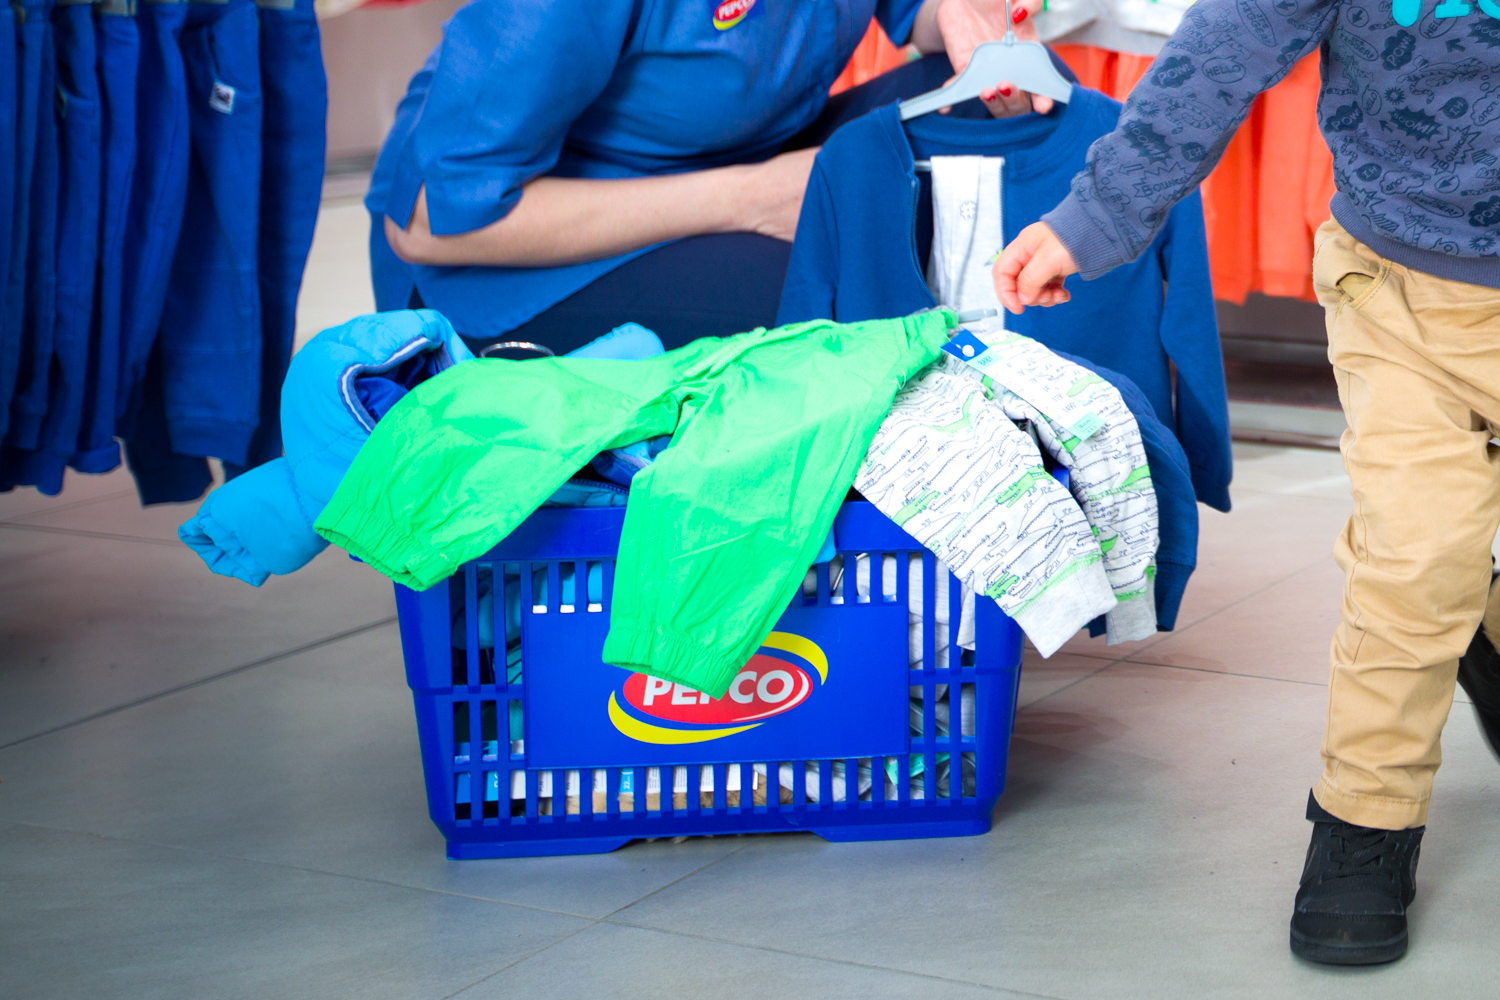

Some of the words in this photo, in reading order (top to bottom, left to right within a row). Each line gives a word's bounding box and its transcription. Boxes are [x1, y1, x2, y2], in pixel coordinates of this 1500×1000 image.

[1386, 34, 1412, 67] POW!
[1158, 63, 1190, 84] POW!
[1205, 63, 1242, 77] HELLO
[1331, 107, 1362, 131] POW!
[1393, 113, 1436, 135] BOOM!
[1474, 201, 1500, 224] POW!
[643, 670, 794, 706] PECO
